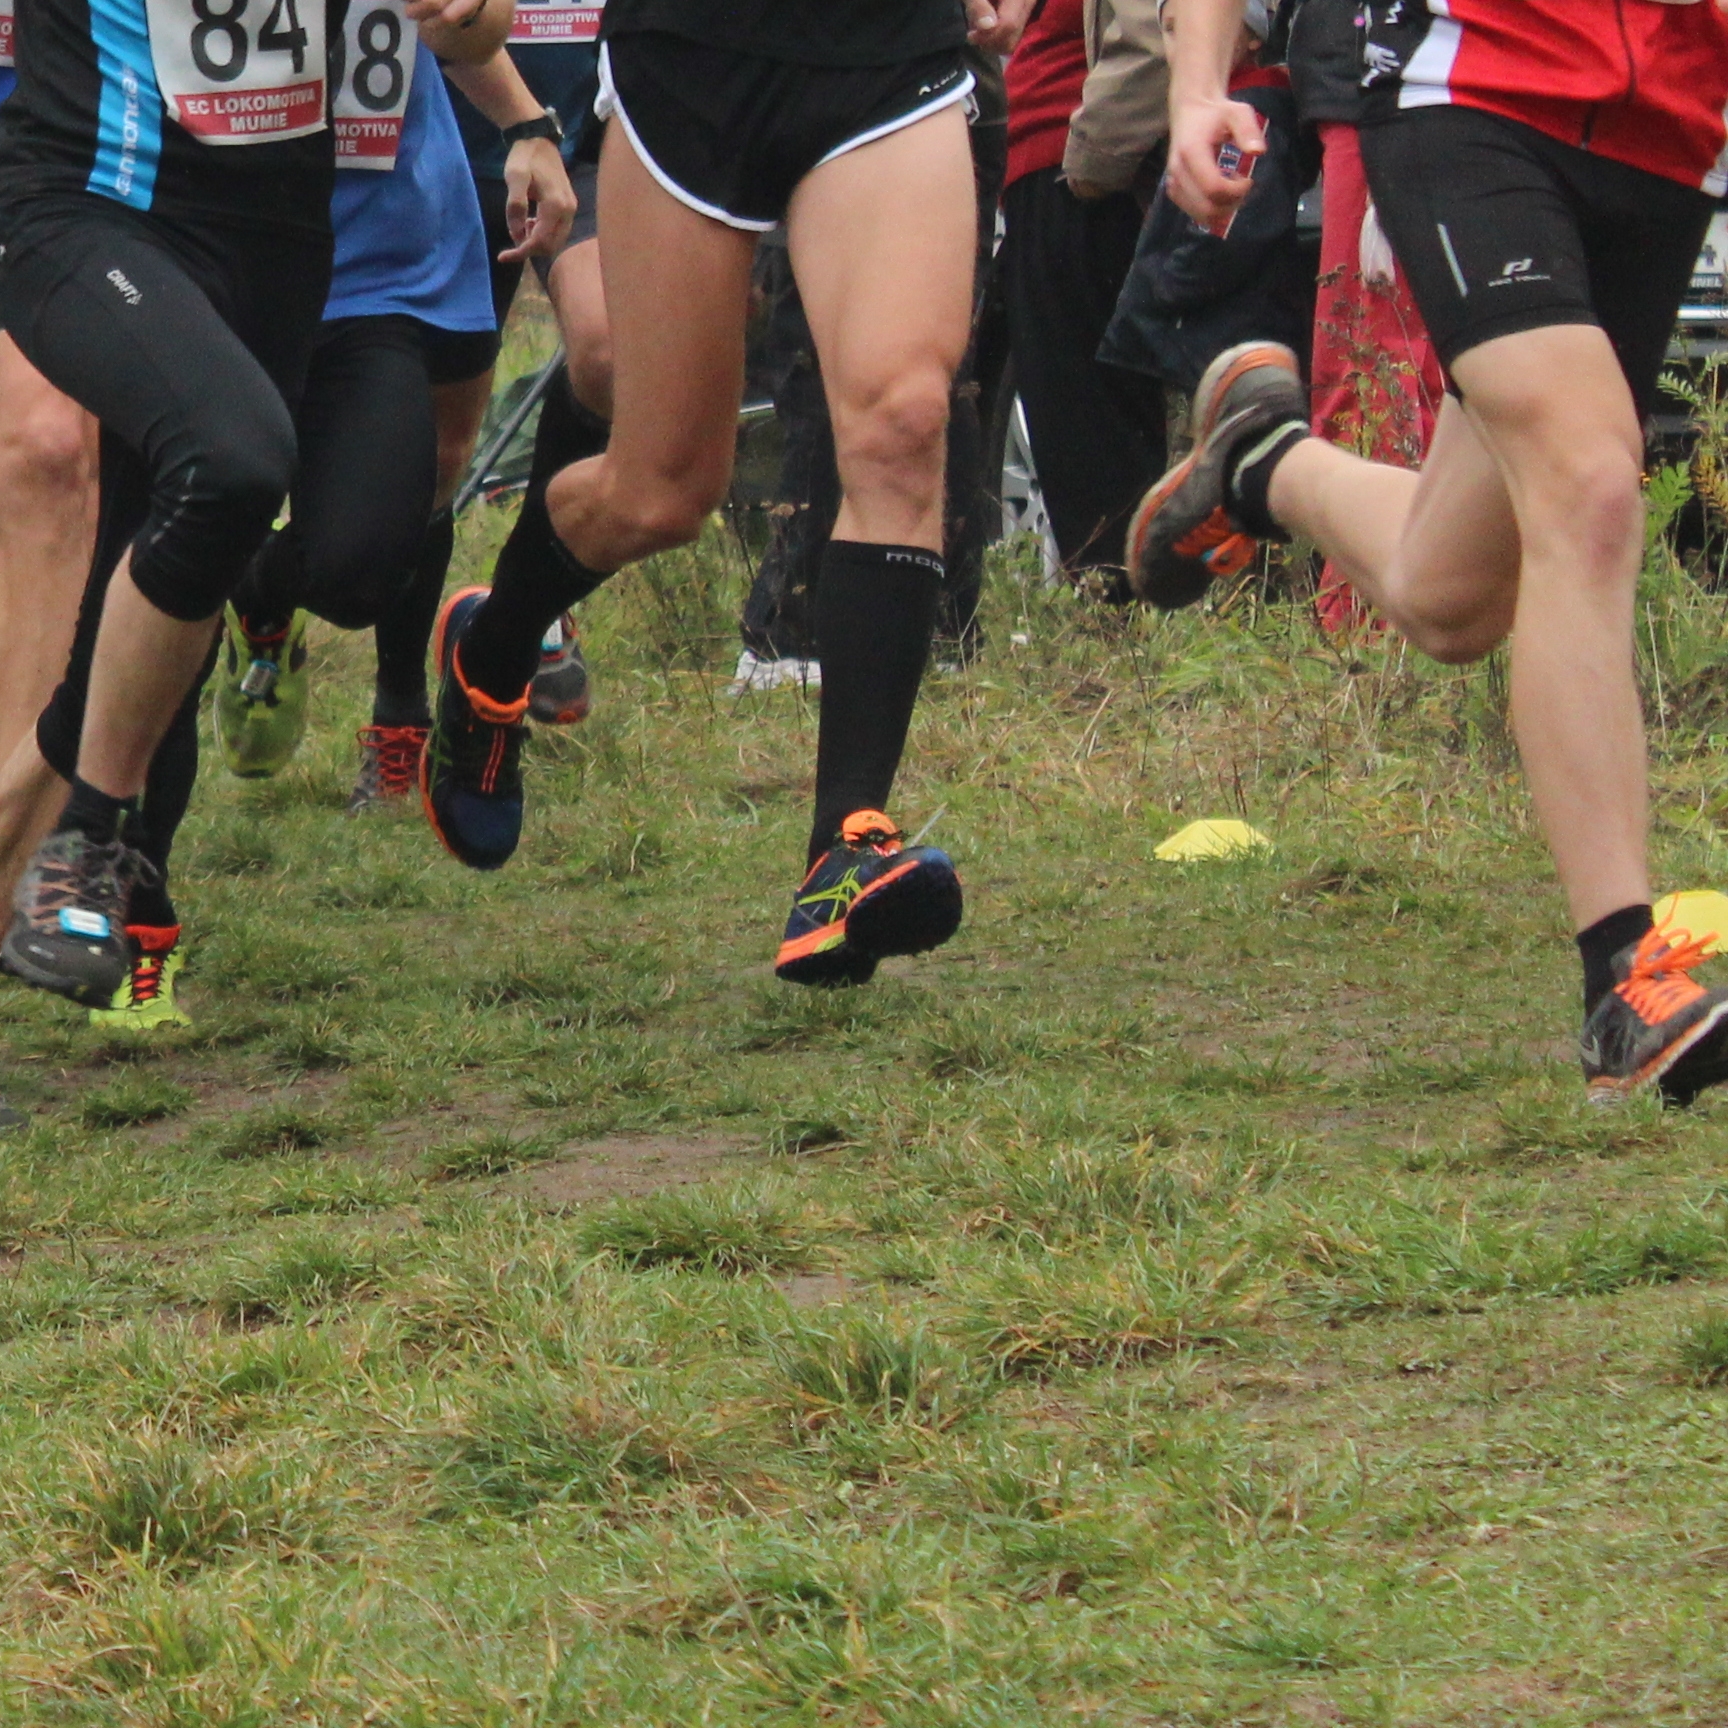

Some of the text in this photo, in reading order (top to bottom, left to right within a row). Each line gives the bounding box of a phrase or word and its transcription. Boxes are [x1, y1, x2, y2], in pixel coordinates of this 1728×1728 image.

[522, 12, 600, 25] LOKOMOTIVA
[531, 24, 573, 35] MUMIE
[332, 8, 404, 112] 8
[185, 87, 317, 115] EC LOKOMOTIVA
[230, 112, 288, 132] MUMIE
[335, 123, 398, 138] MOTIVA
